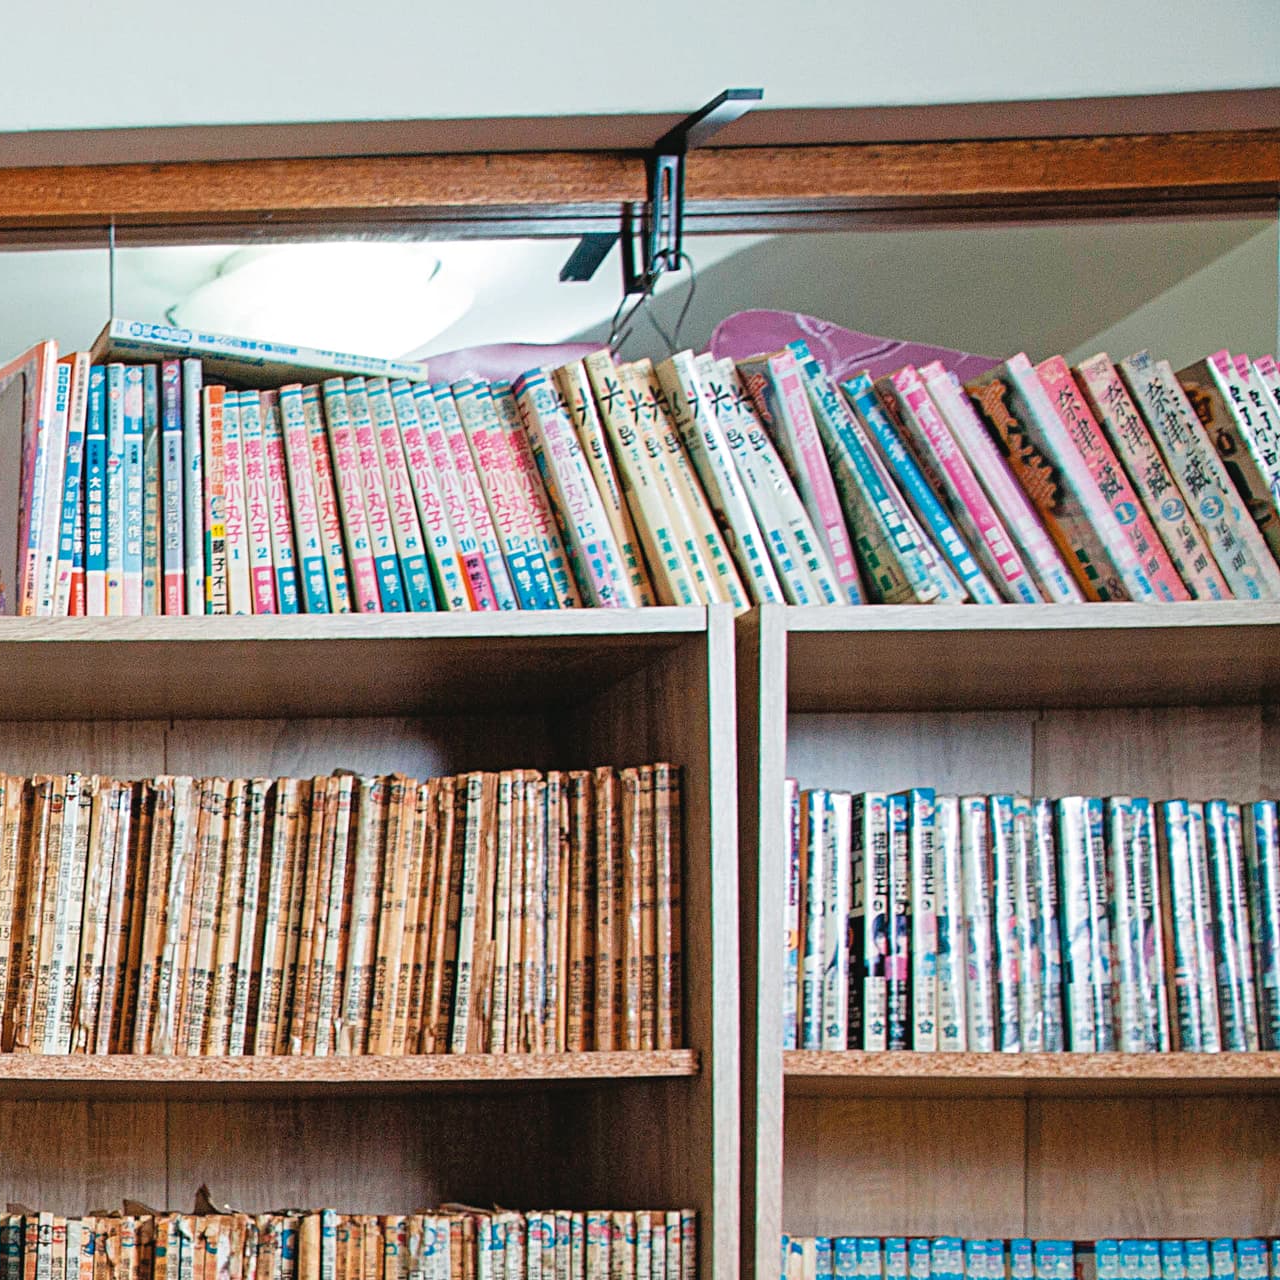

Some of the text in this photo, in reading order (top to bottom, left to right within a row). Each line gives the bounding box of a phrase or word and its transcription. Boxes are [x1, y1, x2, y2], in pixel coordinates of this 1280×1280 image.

[224, 441, 243, 544] 櫻桃小丸子
[243, 439, 270, 543] 櫻桃小丸子
[266, 440, 292, 544] 櫻桃小丸子
[288, 429, 316, 533] 櫻桃小丸子
[311, 434, 341, 540] 櫻桃小丸子
[334, 427, 368, 534] 櫻桃小丸子
[355, 427, 388, 533] 櫻桃小丸子
[379, 427, 416, 533] 櫻桃小丸子
[403, 427, 444, 531] 櫻桃小丸子
[427, 431, 468, 534] 櫻桃小丸子
[449, 433, 491, 536] 櫻桃小丸子
[472, 430, 514, 533] 櫻桃小丸子
[490, 431, 533, 535] 櫻桃小丸子
[508, 429, 552, 534] 櫻桃小丸子
[544, 419, 587, 522] 櫻桃小丸子
[232, 549, 239, 560] 1
[257, 547, 267, 559] 2
[280, 548, 293, 560] 3
[305, 537, 317, 549] 4
[331, 544, 343, 556] 5
[354, 538, 367, 549] 6
[377, 536, 388, 548] 7
[405, 536, 417, 549] 8
[435, 536, 448, 548] 9
[459, 538, 477, 551] 10
[482, 539, 497, 553] 11
[505, 535, 522, 550] 12
[523, 537, 539, 552] 13
[541, 536, 559, 552] 14
[576, 522, 596, 539] 15
